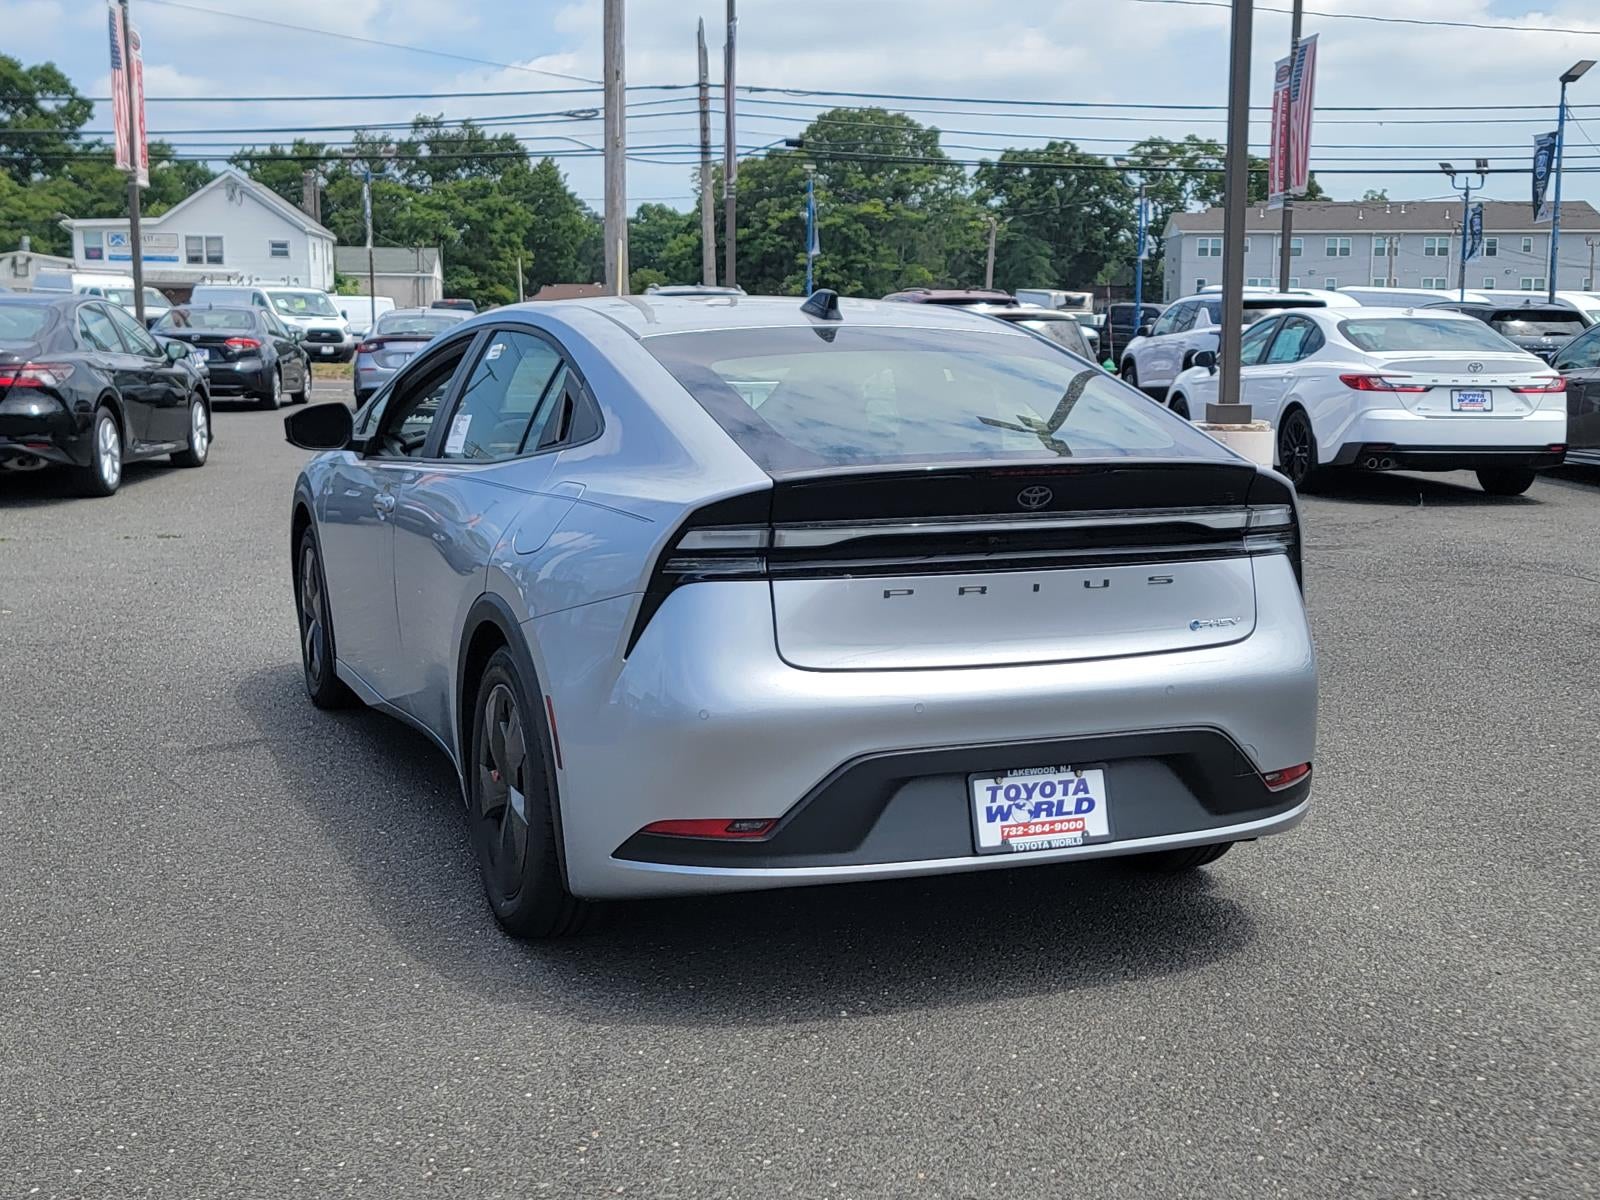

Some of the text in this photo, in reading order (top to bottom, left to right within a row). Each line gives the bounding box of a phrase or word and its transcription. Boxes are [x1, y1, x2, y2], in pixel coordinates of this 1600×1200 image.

[883, 574, 1174, 599] PRIUS
[1007, 765, 1071, 778] LAKEWOOD, NJ
[986, 778, 1090, 804] TOYOTA
[986, 797, 1096, 824] WORLD
[1003, 820, 1083, 836] 732-364-9000
[1012, 837, 1083, 852] TOYOTA WORLD
